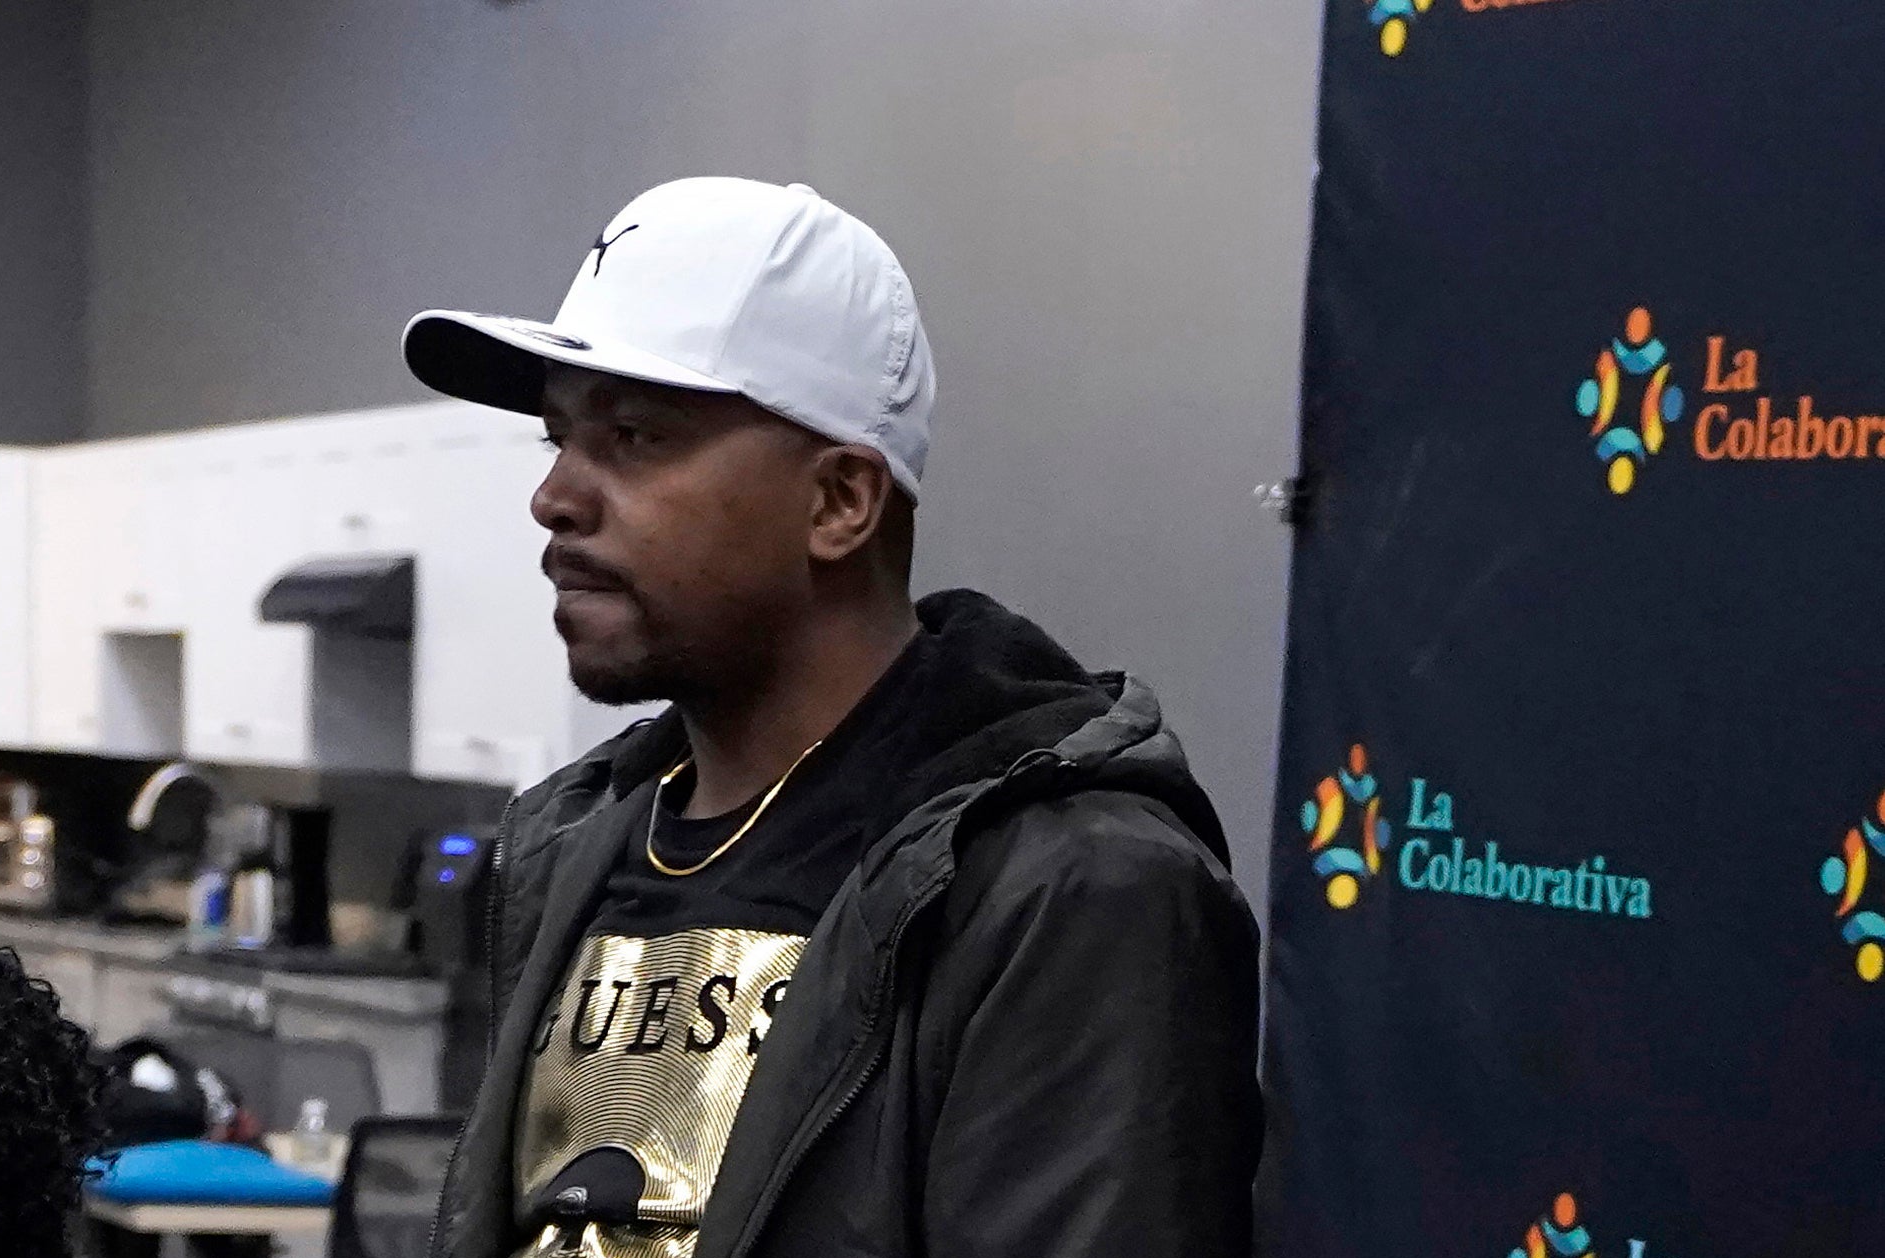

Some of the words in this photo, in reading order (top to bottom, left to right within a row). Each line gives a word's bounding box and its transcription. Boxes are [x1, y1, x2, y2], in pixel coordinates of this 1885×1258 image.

[1702, 336, 1757, 392] La
[1406, 777, 1454, 831] La
[1399, 837, 1652, 919] Colaborativa
[534, 974, 792, 1056] UES
